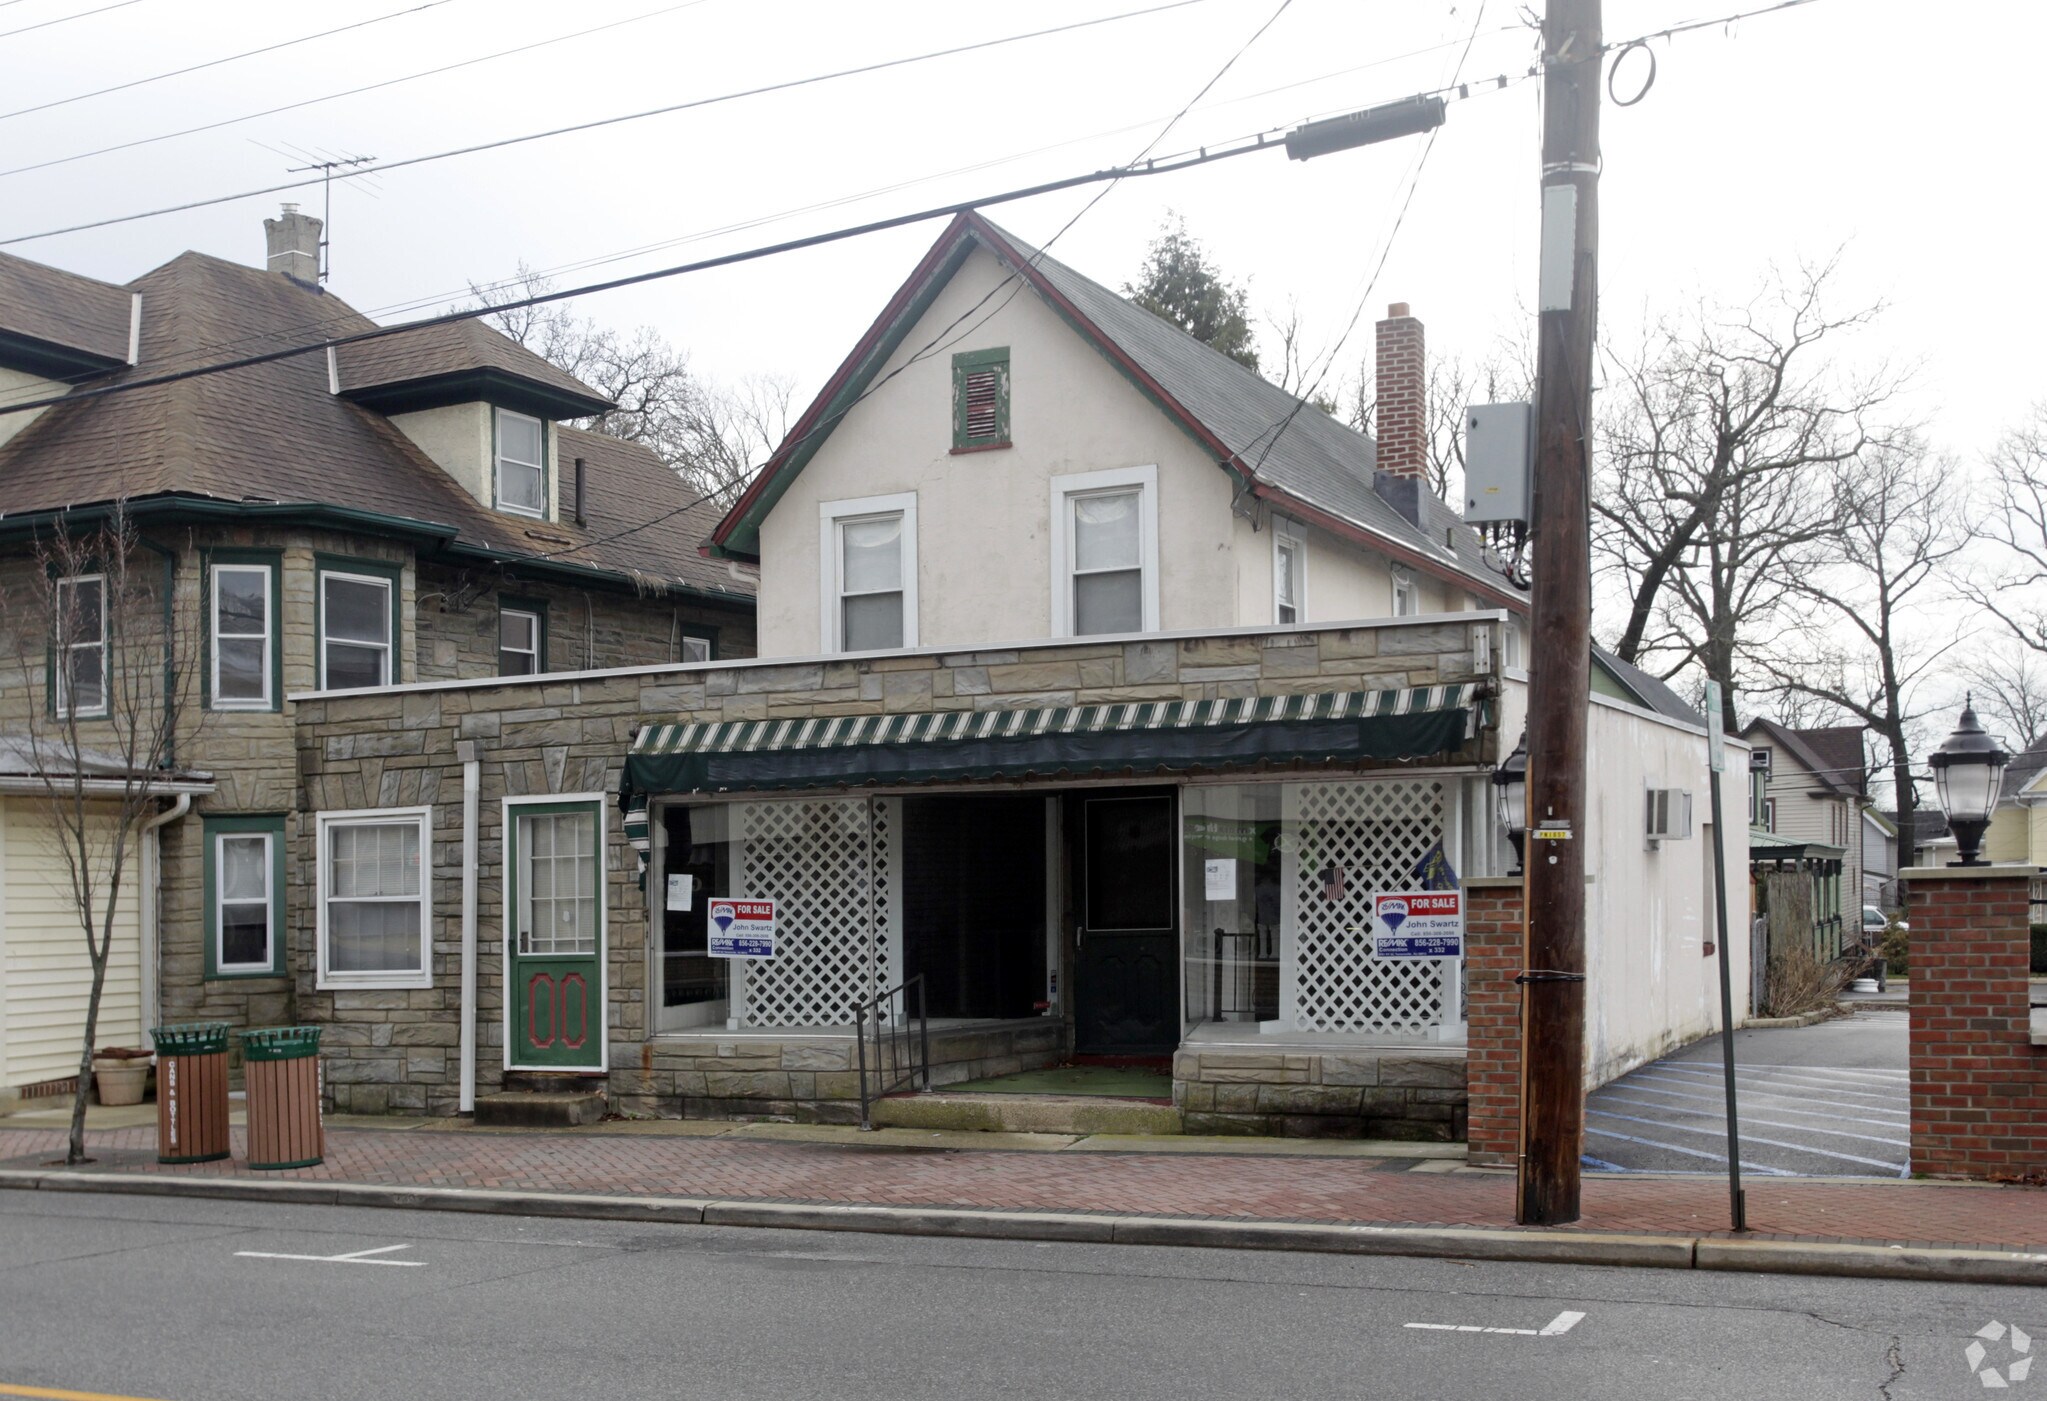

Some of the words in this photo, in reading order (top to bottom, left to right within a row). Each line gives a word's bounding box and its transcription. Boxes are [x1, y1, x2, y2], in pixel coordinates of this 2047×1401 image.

[1411, 899, 1430, 908] FOR
[1432, 898, 1455, 908] SALE
[738, 905, 751, 914] FOR
[753, 905, 770, 914] SALE
[1414, 938, 1459, 946] 856-228-7990
[169, 1099, 177, 1144] BOTTLES
